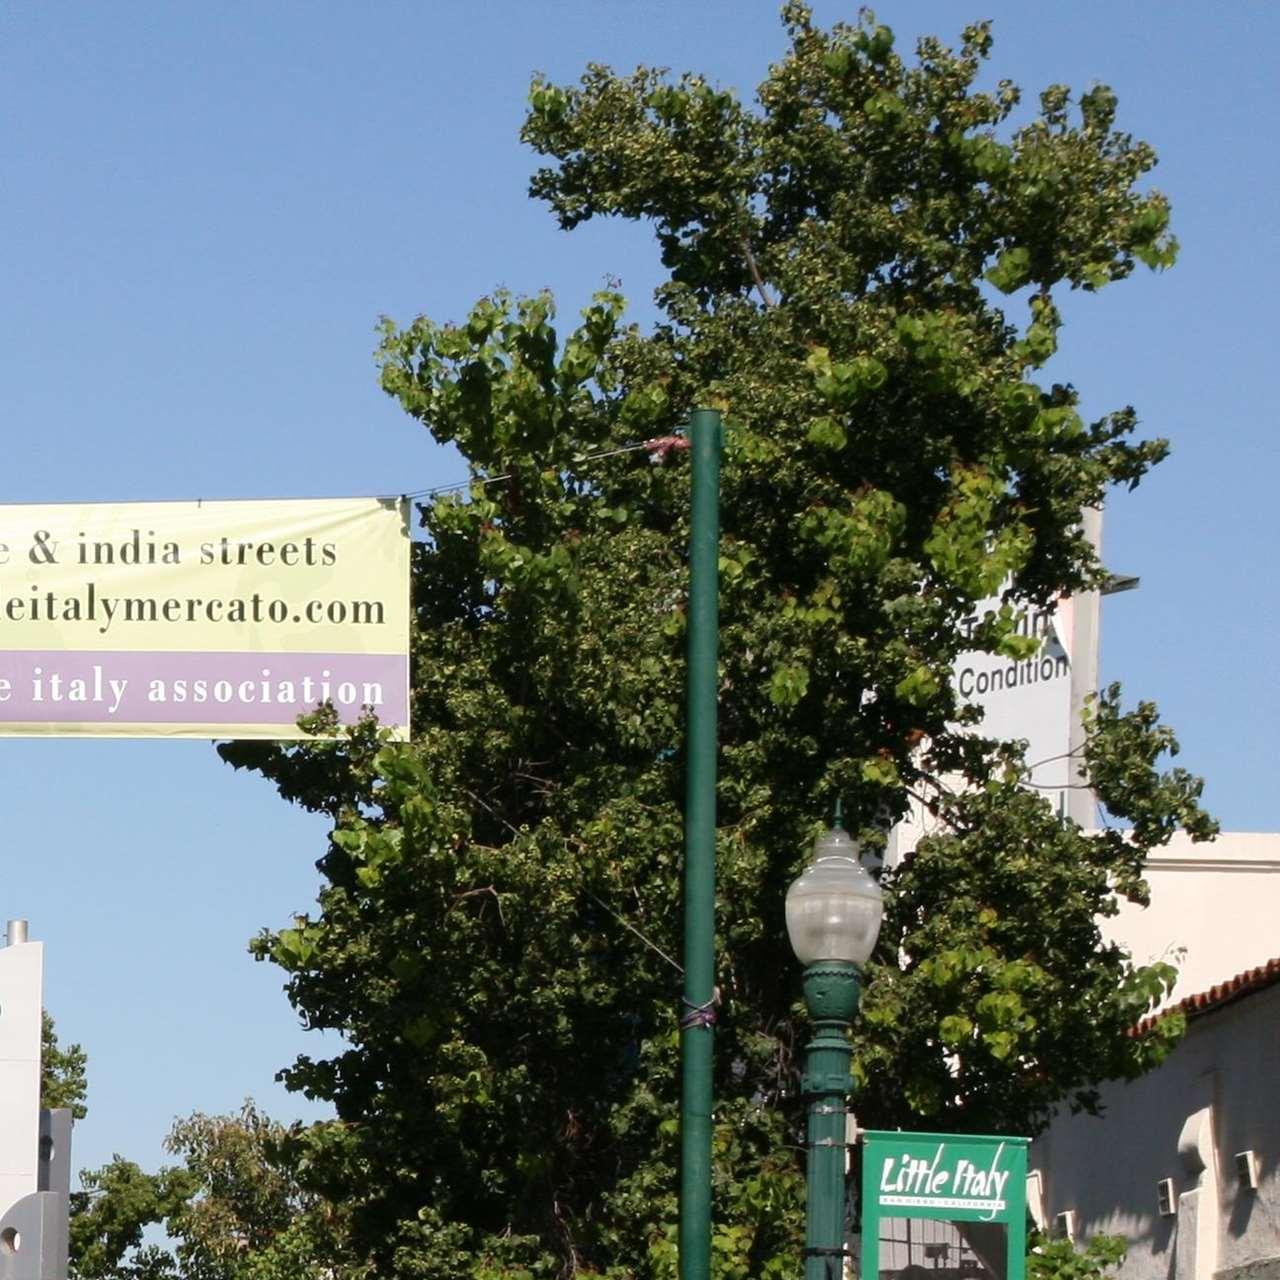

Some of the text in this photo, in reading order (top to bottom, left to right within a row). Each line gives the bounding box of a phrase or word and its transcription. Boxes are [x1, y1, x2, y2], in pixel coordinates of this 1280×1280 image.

[28, 529, 60, 565] &
[77, 530, 181, 565] india
[200, 536, 337, 567] streets
[32, 666, 128, 712] italy
[148, 670, 384, 705] association
[880, 1141, 1010, 1221] Little Italy
